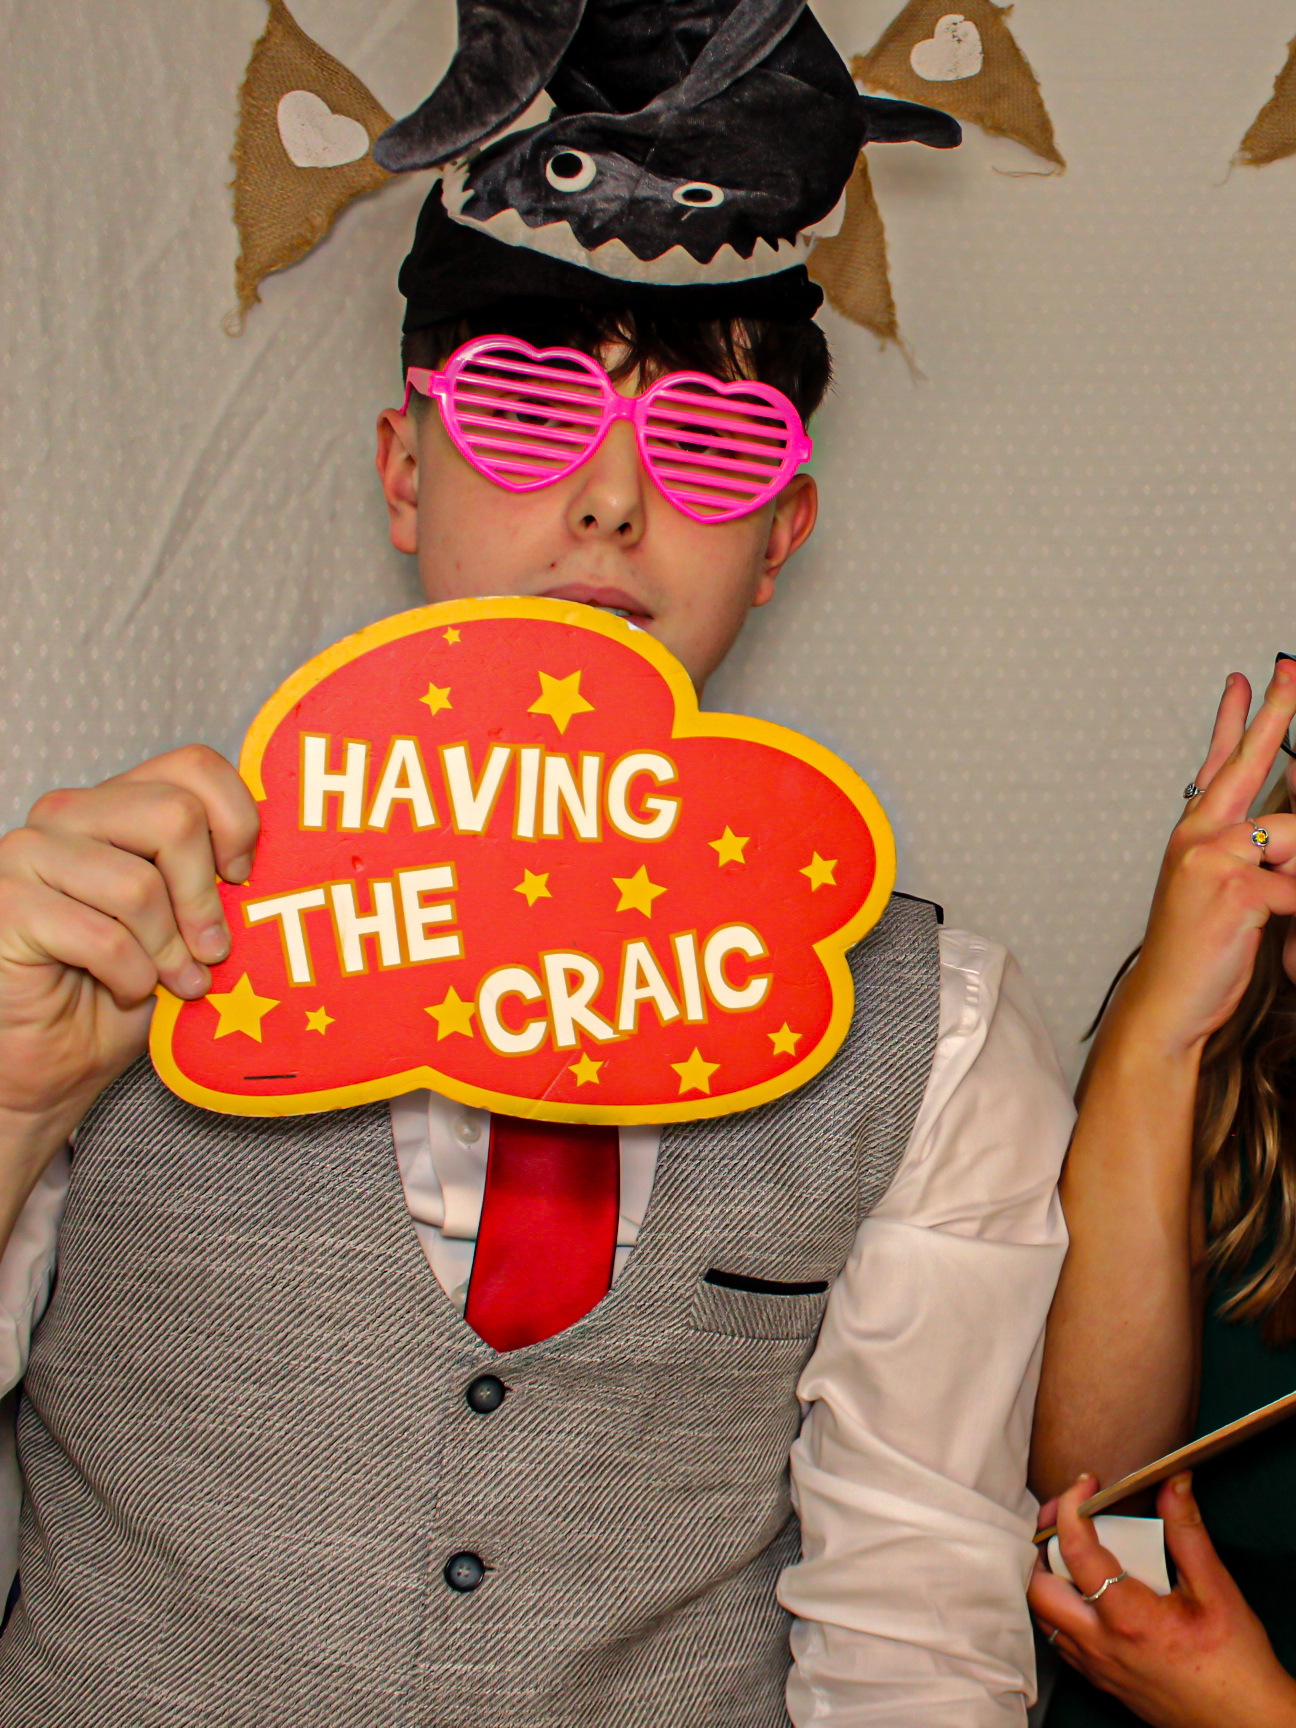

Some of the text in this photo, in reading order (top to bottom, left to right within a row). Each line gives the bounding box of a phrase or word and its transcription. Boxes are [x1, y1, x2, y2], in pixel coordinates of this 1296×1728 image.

[302, 735, 679, 841] HAVING
[245, 865, 463, 985] THE
[478, 924, 771, 1054] CRAIC
